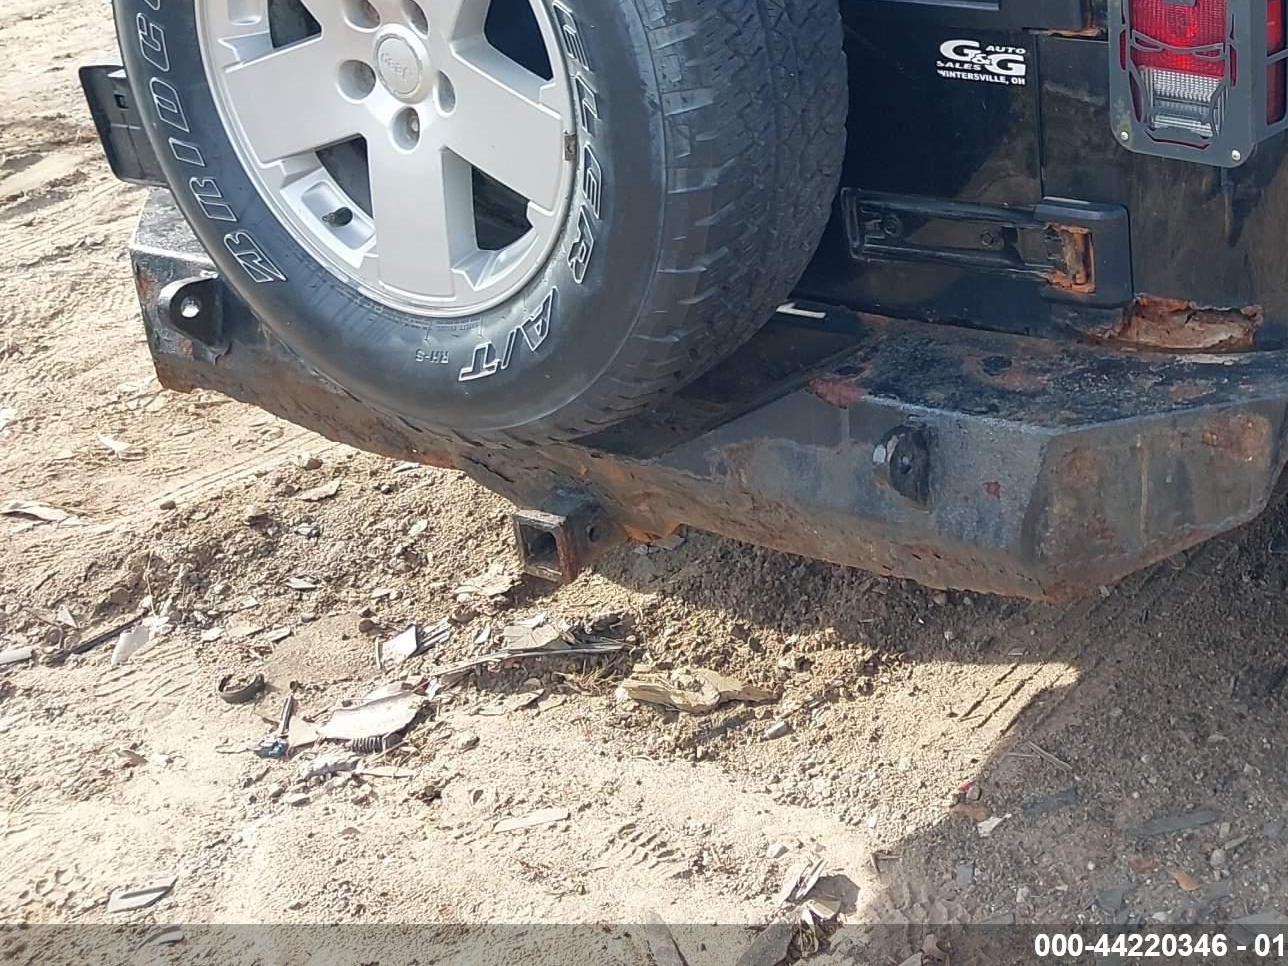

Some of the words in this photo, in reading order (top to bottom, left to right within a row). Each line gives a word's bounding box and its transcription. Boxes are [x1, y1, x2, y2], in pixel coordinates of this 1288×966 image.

[986, 45, 1026, 54] AUTO
[940, 40, 1026, 76] G&G
[936, 61, 981, 71] SALES
[937, 70, 1009, 85] WINTERSVILLE,
[1011, 77, 1026, 85] OH
[458, 286, 559, 381] A/T
